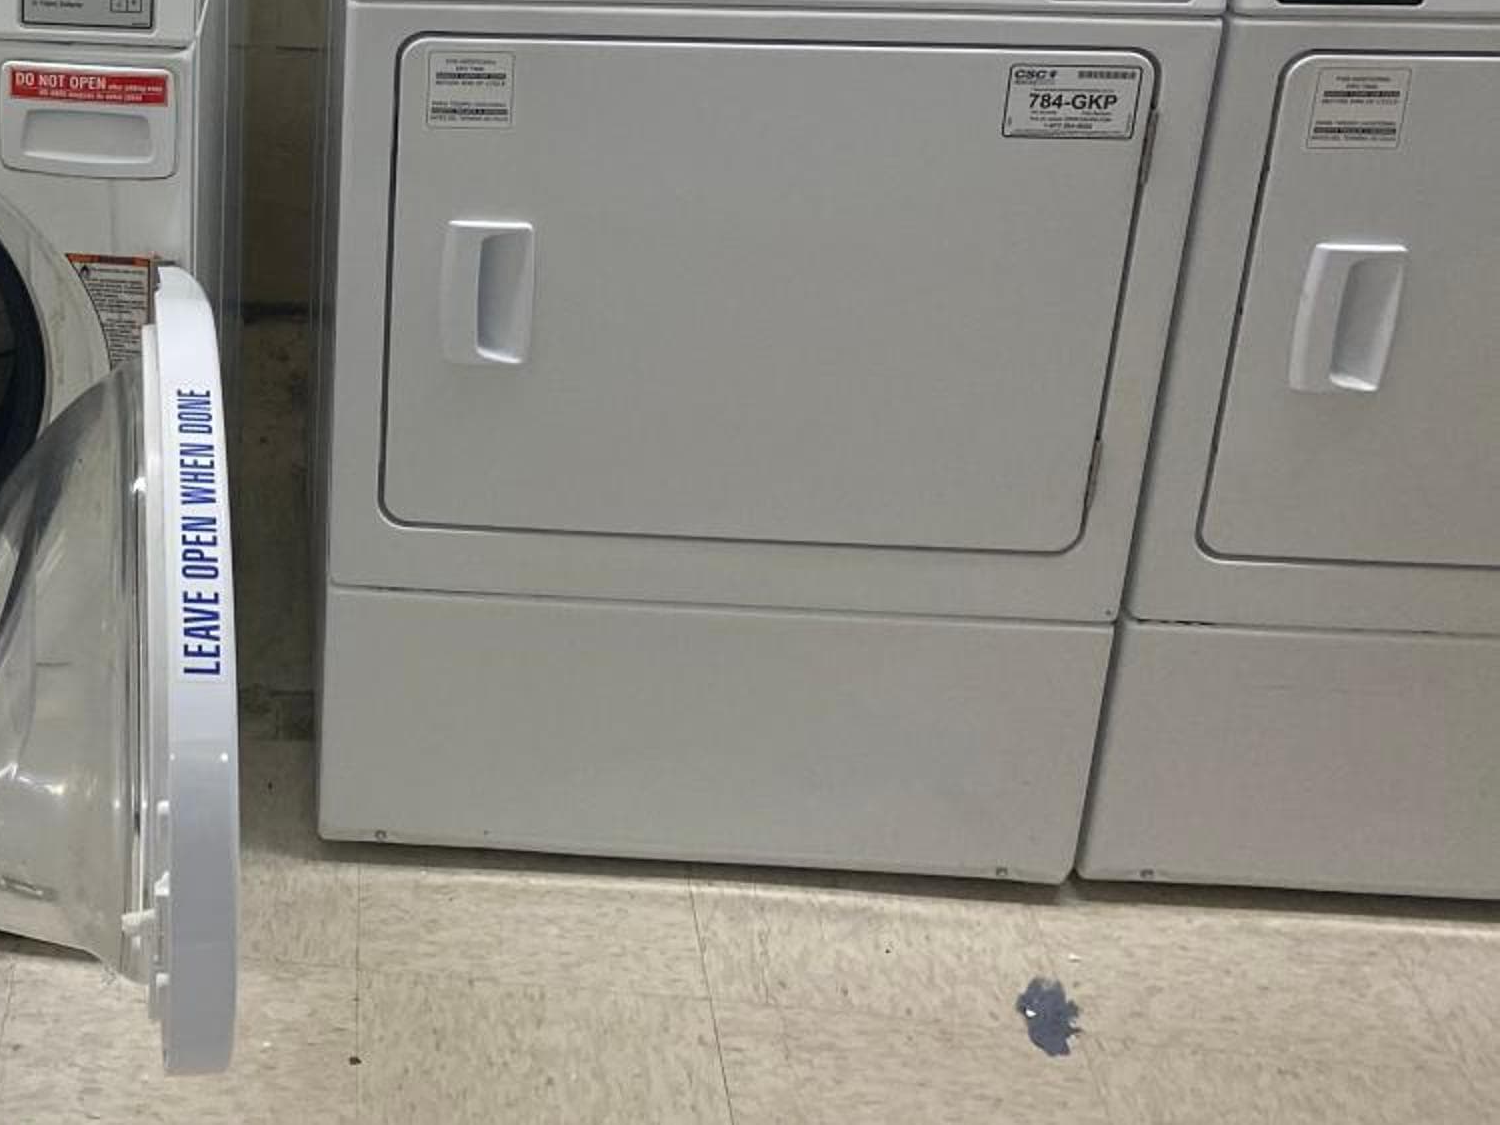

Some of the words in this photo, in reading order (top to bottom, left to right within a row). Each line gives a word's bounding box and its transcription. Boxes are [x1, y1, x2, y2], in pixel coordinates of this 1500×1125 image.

[14, 72, 35, 86] DO
[39, 73, 66, 87] NOT
[69, 75, 107, 91] OPEN
[1029, 93, 1118, 110] 784-GKP
[176, 389, 213, 435] DONE
[179, 442, 217, 505] WHEN
[181, 516, 220, 580] OPEN
[183, 590, 221, 676] LEAVE
